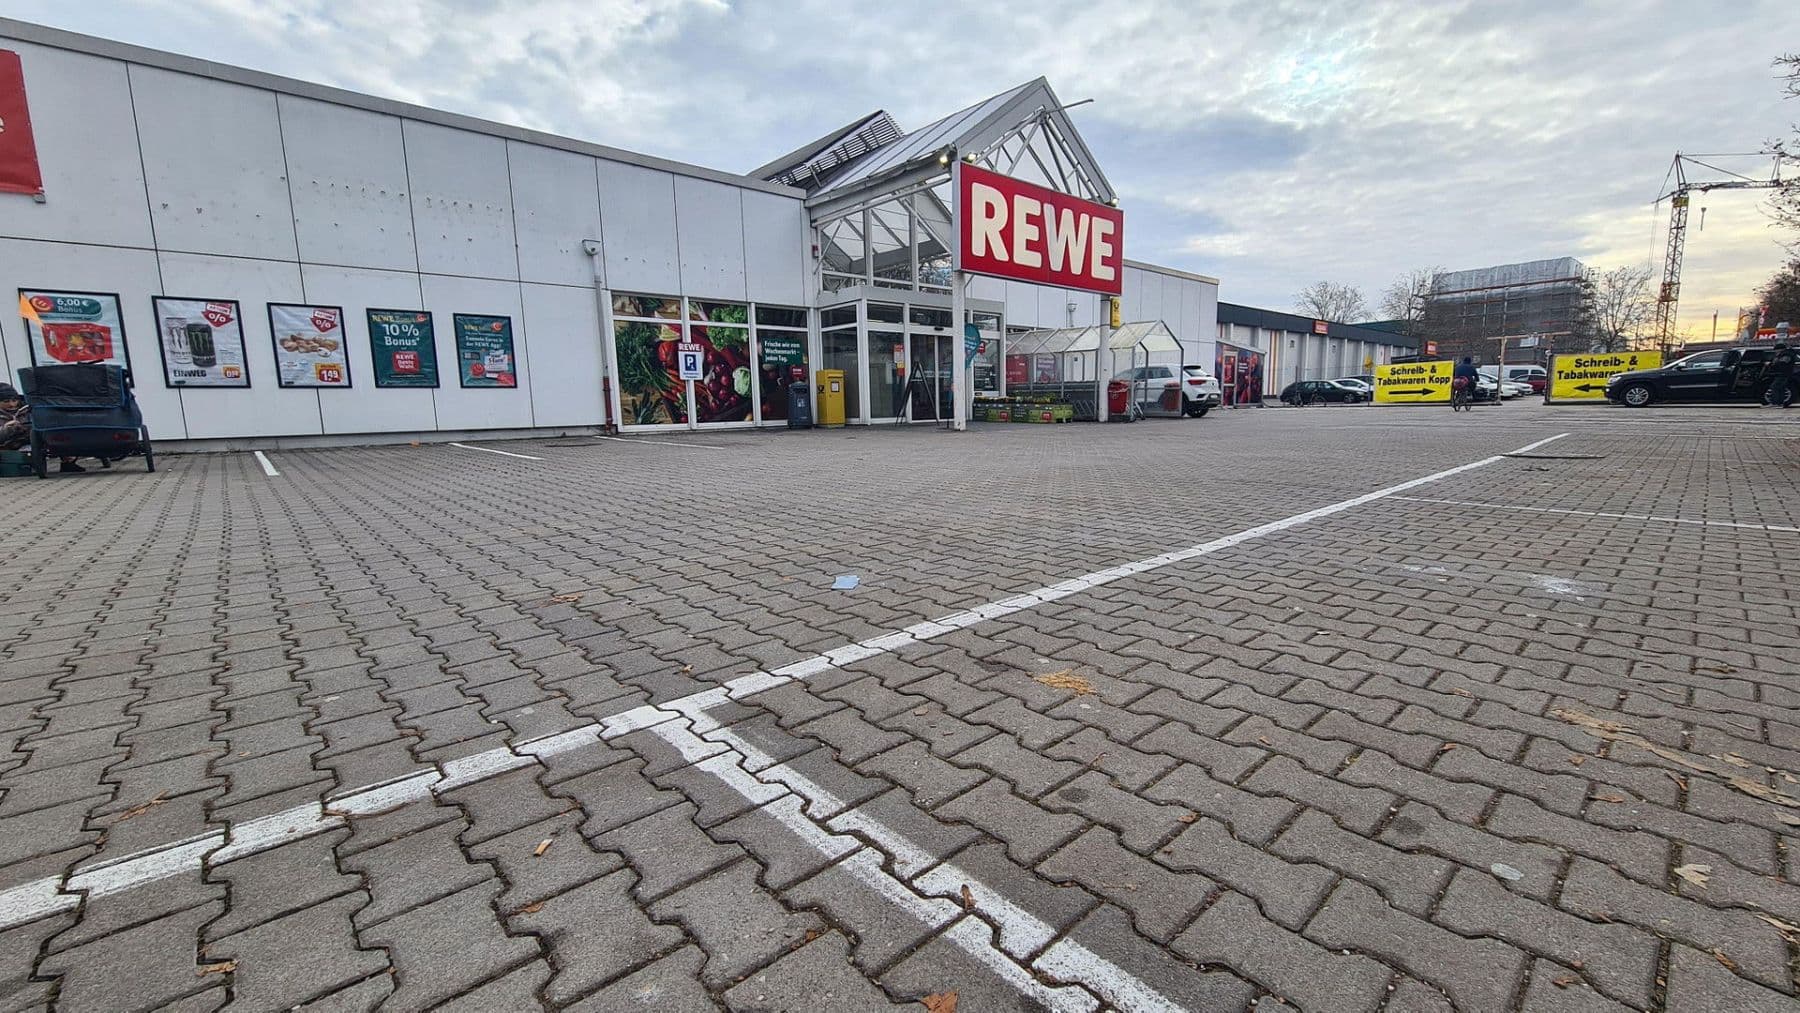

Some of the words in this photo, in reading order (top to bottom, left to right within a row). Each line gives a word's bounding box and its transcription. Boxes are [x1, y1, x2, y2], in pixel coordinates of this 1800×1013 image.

[971, 181, 1115, 281] REWE
[57, 305, 82, 313] Bonus
[678, 343, 701, 351] REWE
[687, 356, 694, 367] P
[1575, 357, 1625, 368] Schreib-
[1629, 355, 1638, 366] &
[1390, 365, 1427, 376] Schreib-
[1430, 364, 1437, 374] &
[1377, 376, 1426, 386] Tabakwaren
[1428, 375, 1451, 386] Kopp
